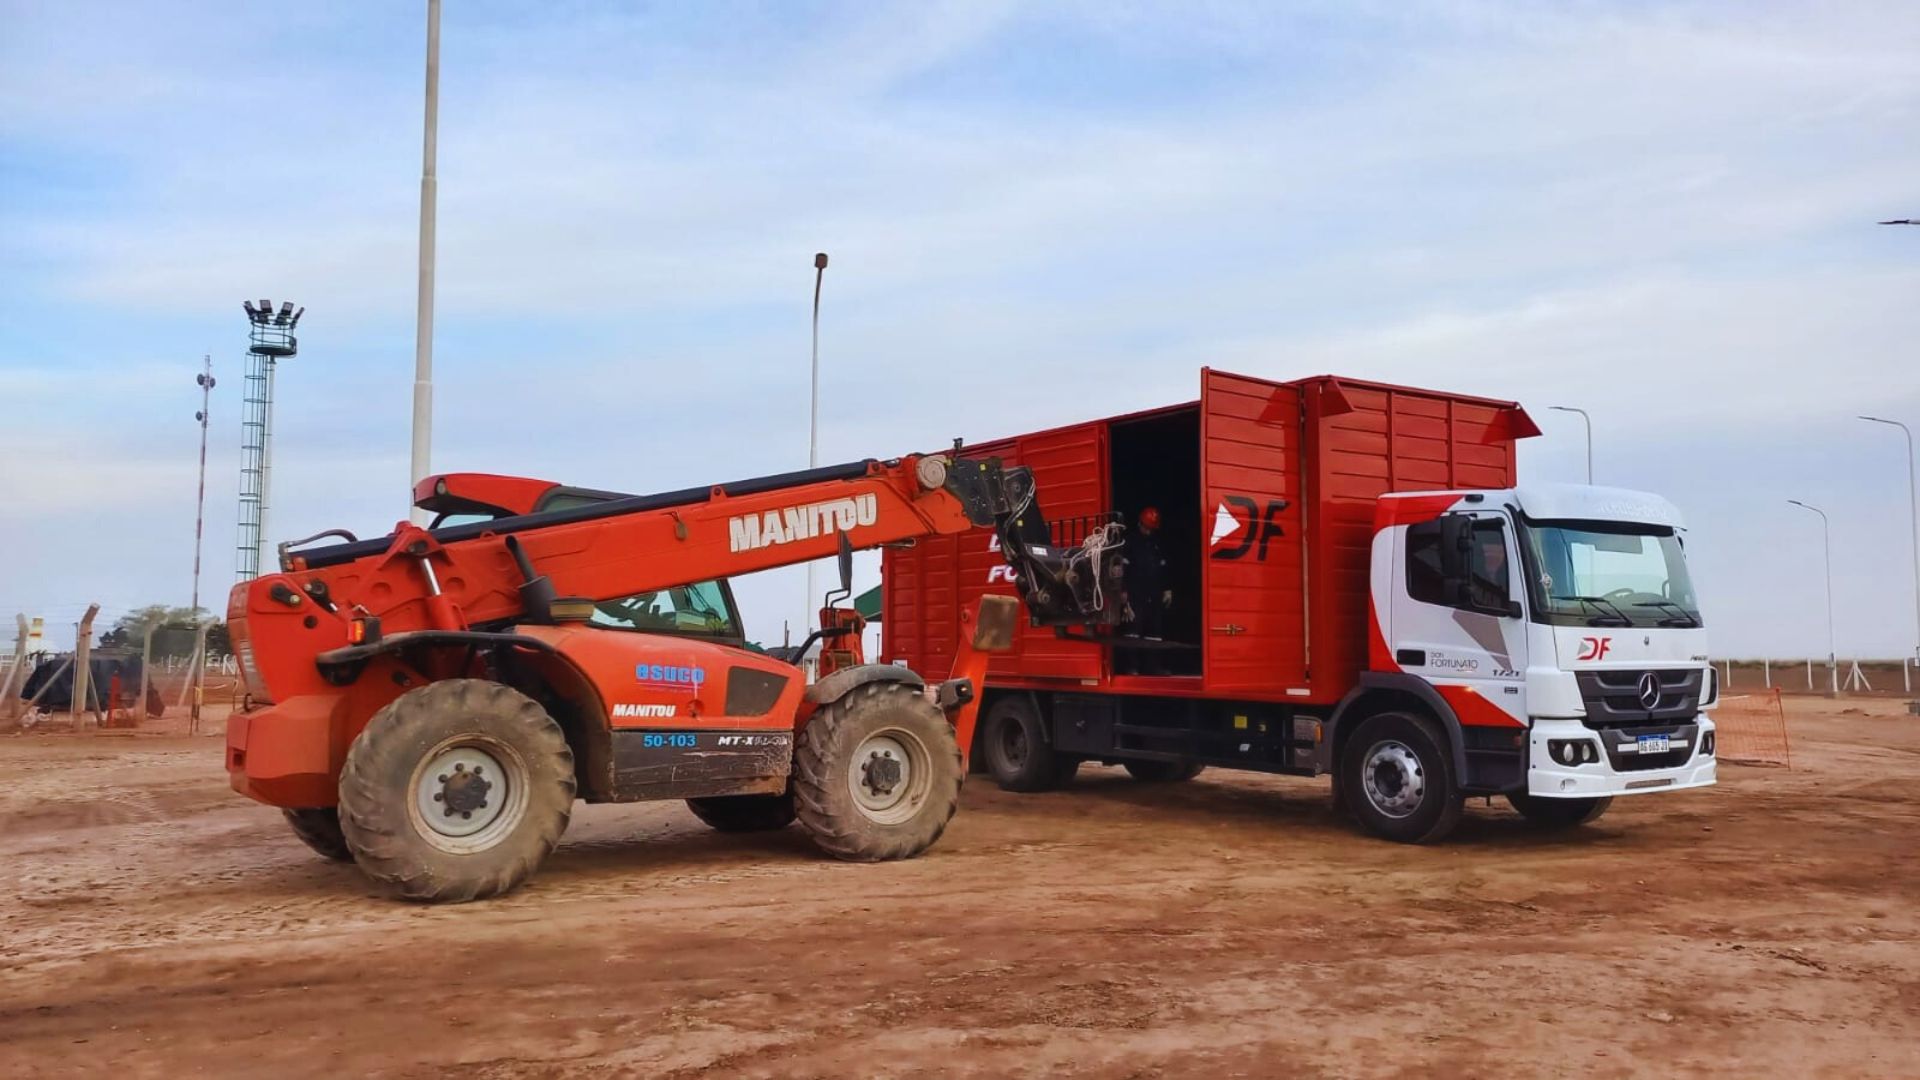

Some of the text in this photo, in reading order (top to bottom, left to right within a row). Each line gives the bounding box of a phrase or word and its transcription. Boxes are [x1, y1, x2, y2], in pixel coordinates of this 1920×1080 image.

[729, 493, 877, 552] MANITOU
[1577, 637, 1612, 660] DF
[1431, 659, 1478, 669] FORTUNATO
[613, 704, 676, 716] MANITOU
[644, 735, 696, 747] 50-103
